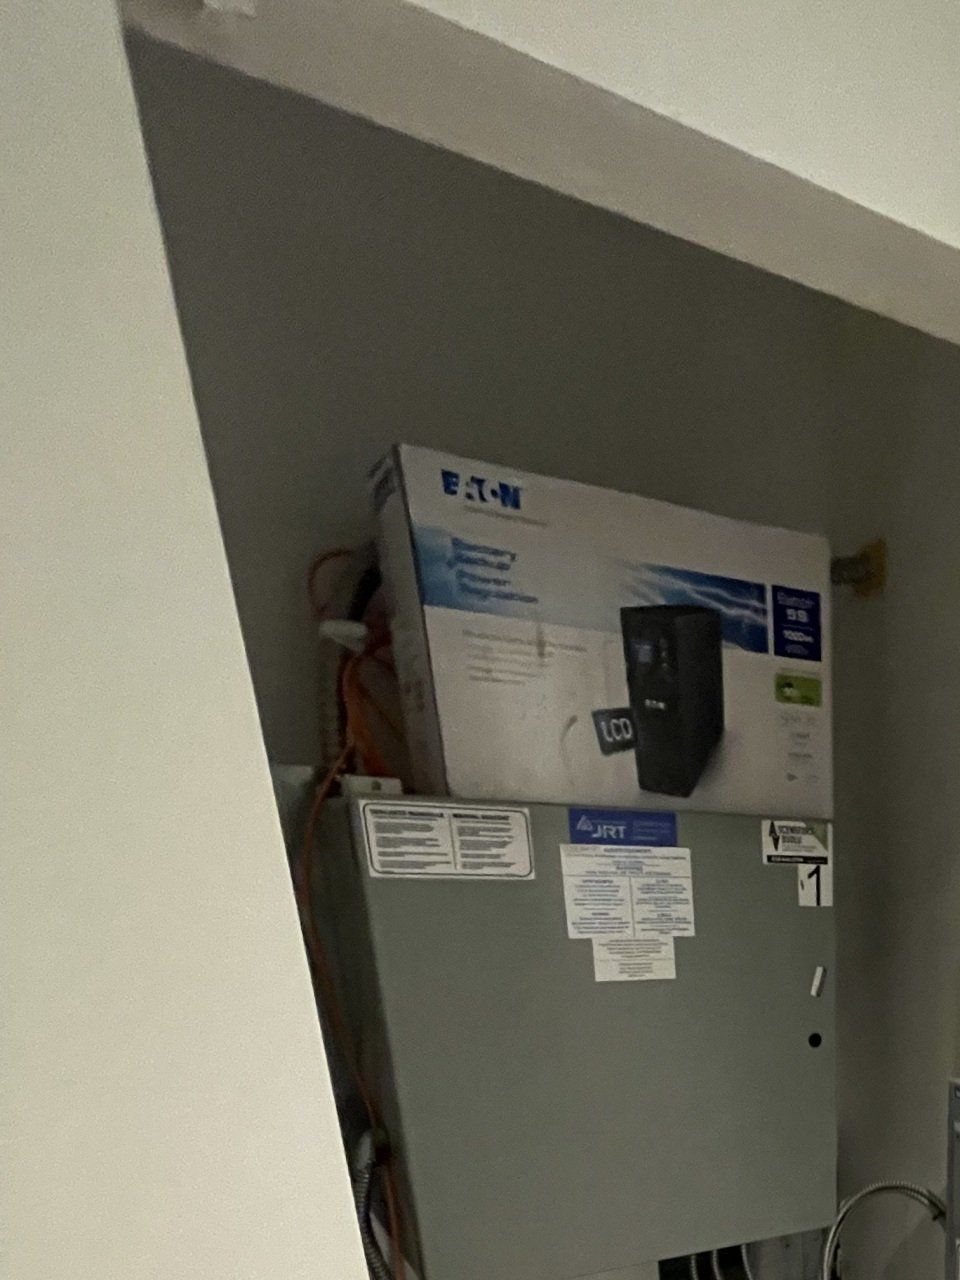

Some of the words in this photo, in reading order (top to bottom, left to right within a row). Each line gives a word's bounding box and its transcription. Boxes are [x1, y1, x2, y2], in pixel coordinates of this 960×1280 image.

[441, 469, 522, 510] EATON
[600, 718, 634, 742] LCD
[591, 824, 627, 840] JRT
[808, 865, 821, 906] 1
